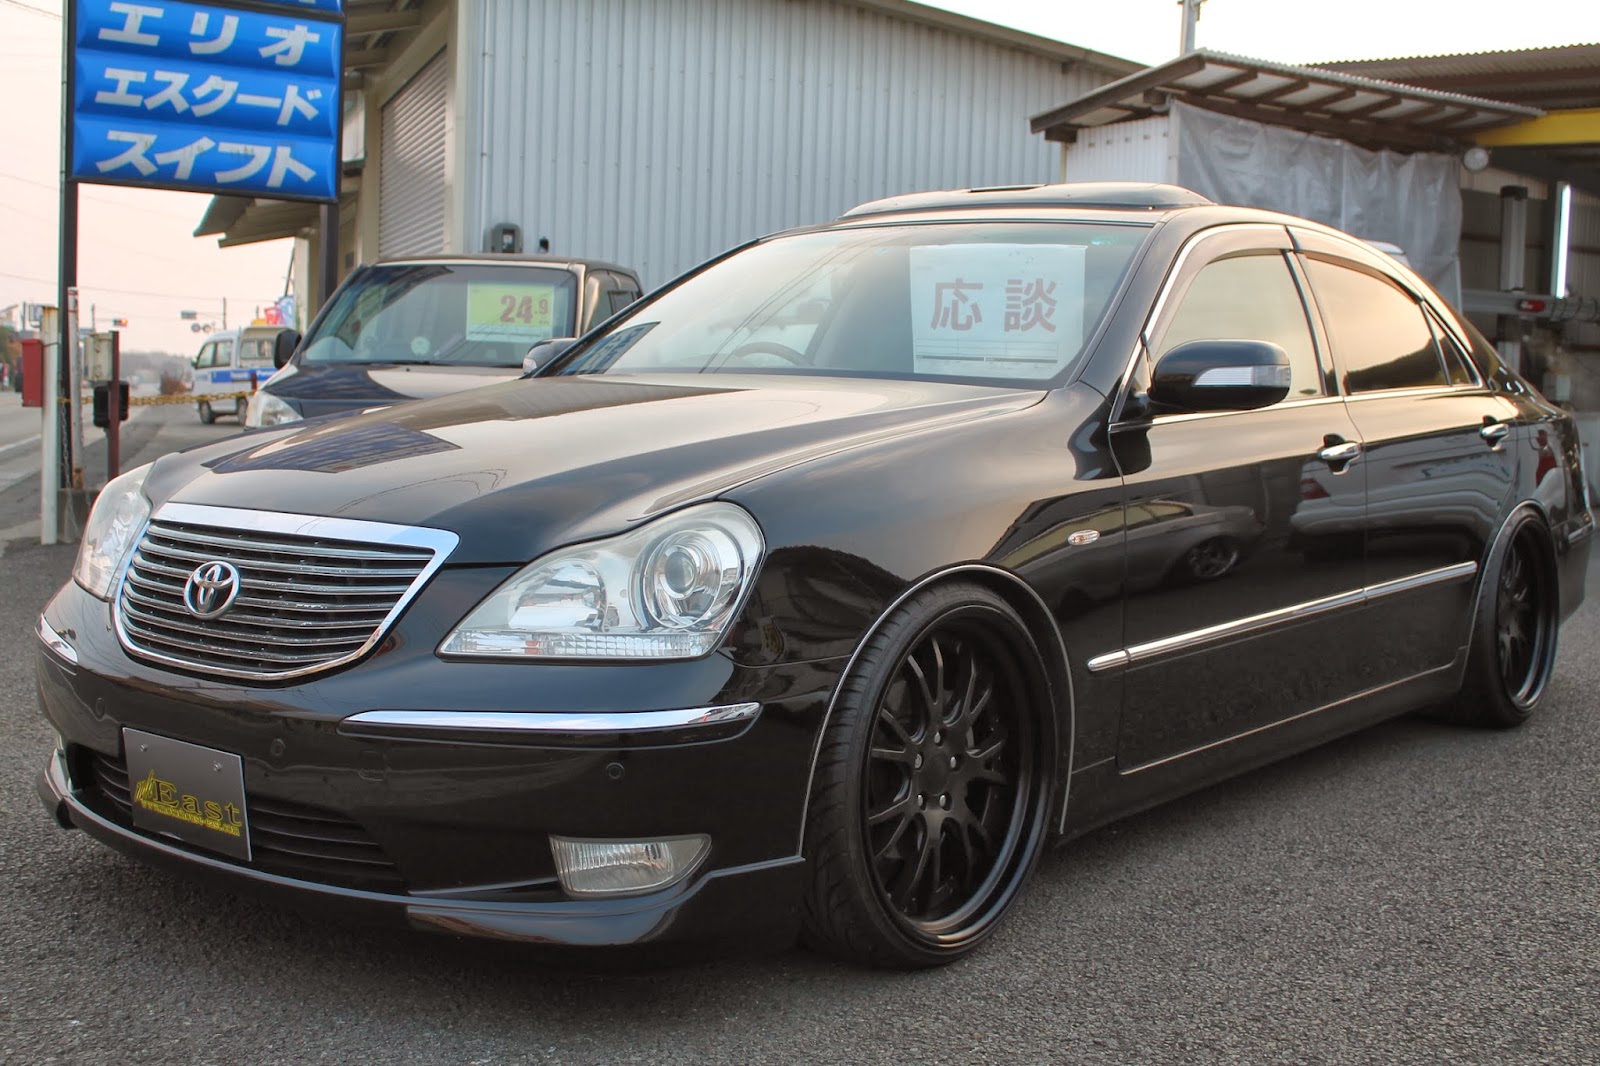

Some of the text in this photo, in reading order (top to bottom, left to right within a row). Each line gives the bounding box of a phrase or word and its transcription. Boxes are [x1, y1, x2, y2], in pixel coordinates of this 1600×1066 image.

[98, 2, 320, 66] エリオ
[95, 67, 322, 125] エスクード
[96, 130, 316, 188] スイフト
[930, 278, 1058, 332] 応談
